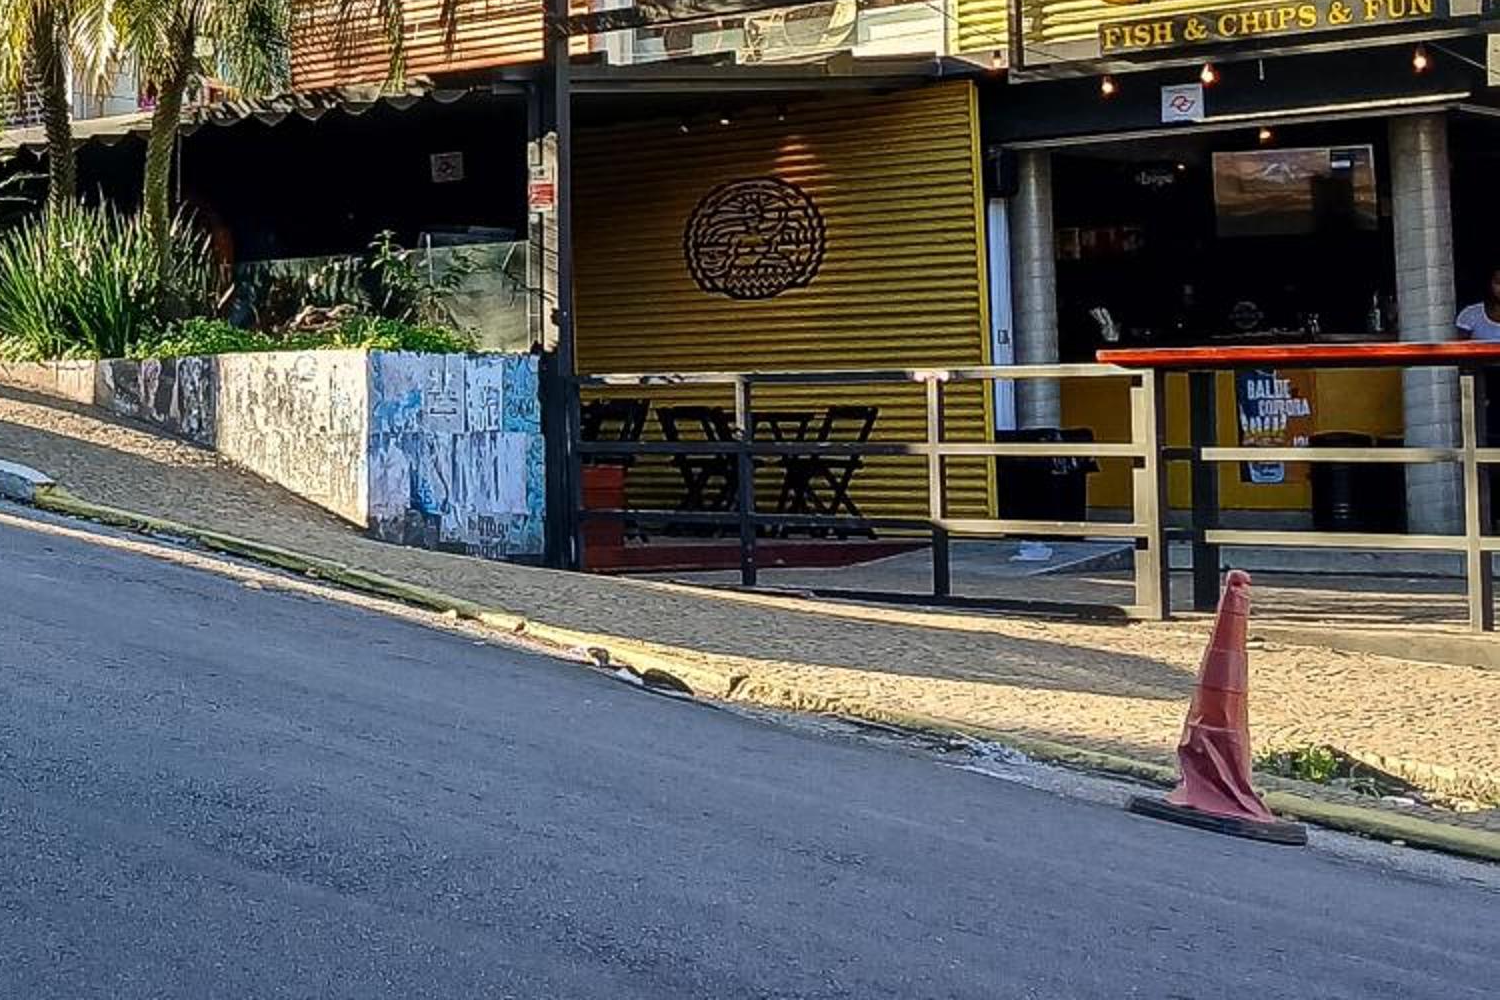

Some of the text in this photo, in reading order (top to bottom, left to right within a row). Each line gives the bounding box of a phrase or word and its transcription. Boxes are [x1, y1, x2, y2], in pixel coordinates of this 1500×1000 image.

[1102, 21, 1174, 50] FISH
[1184, 19, 1209, 41] &
[1218, 4, 1318, 37] CHIPS
[1327, 2, 1353, 24] &
